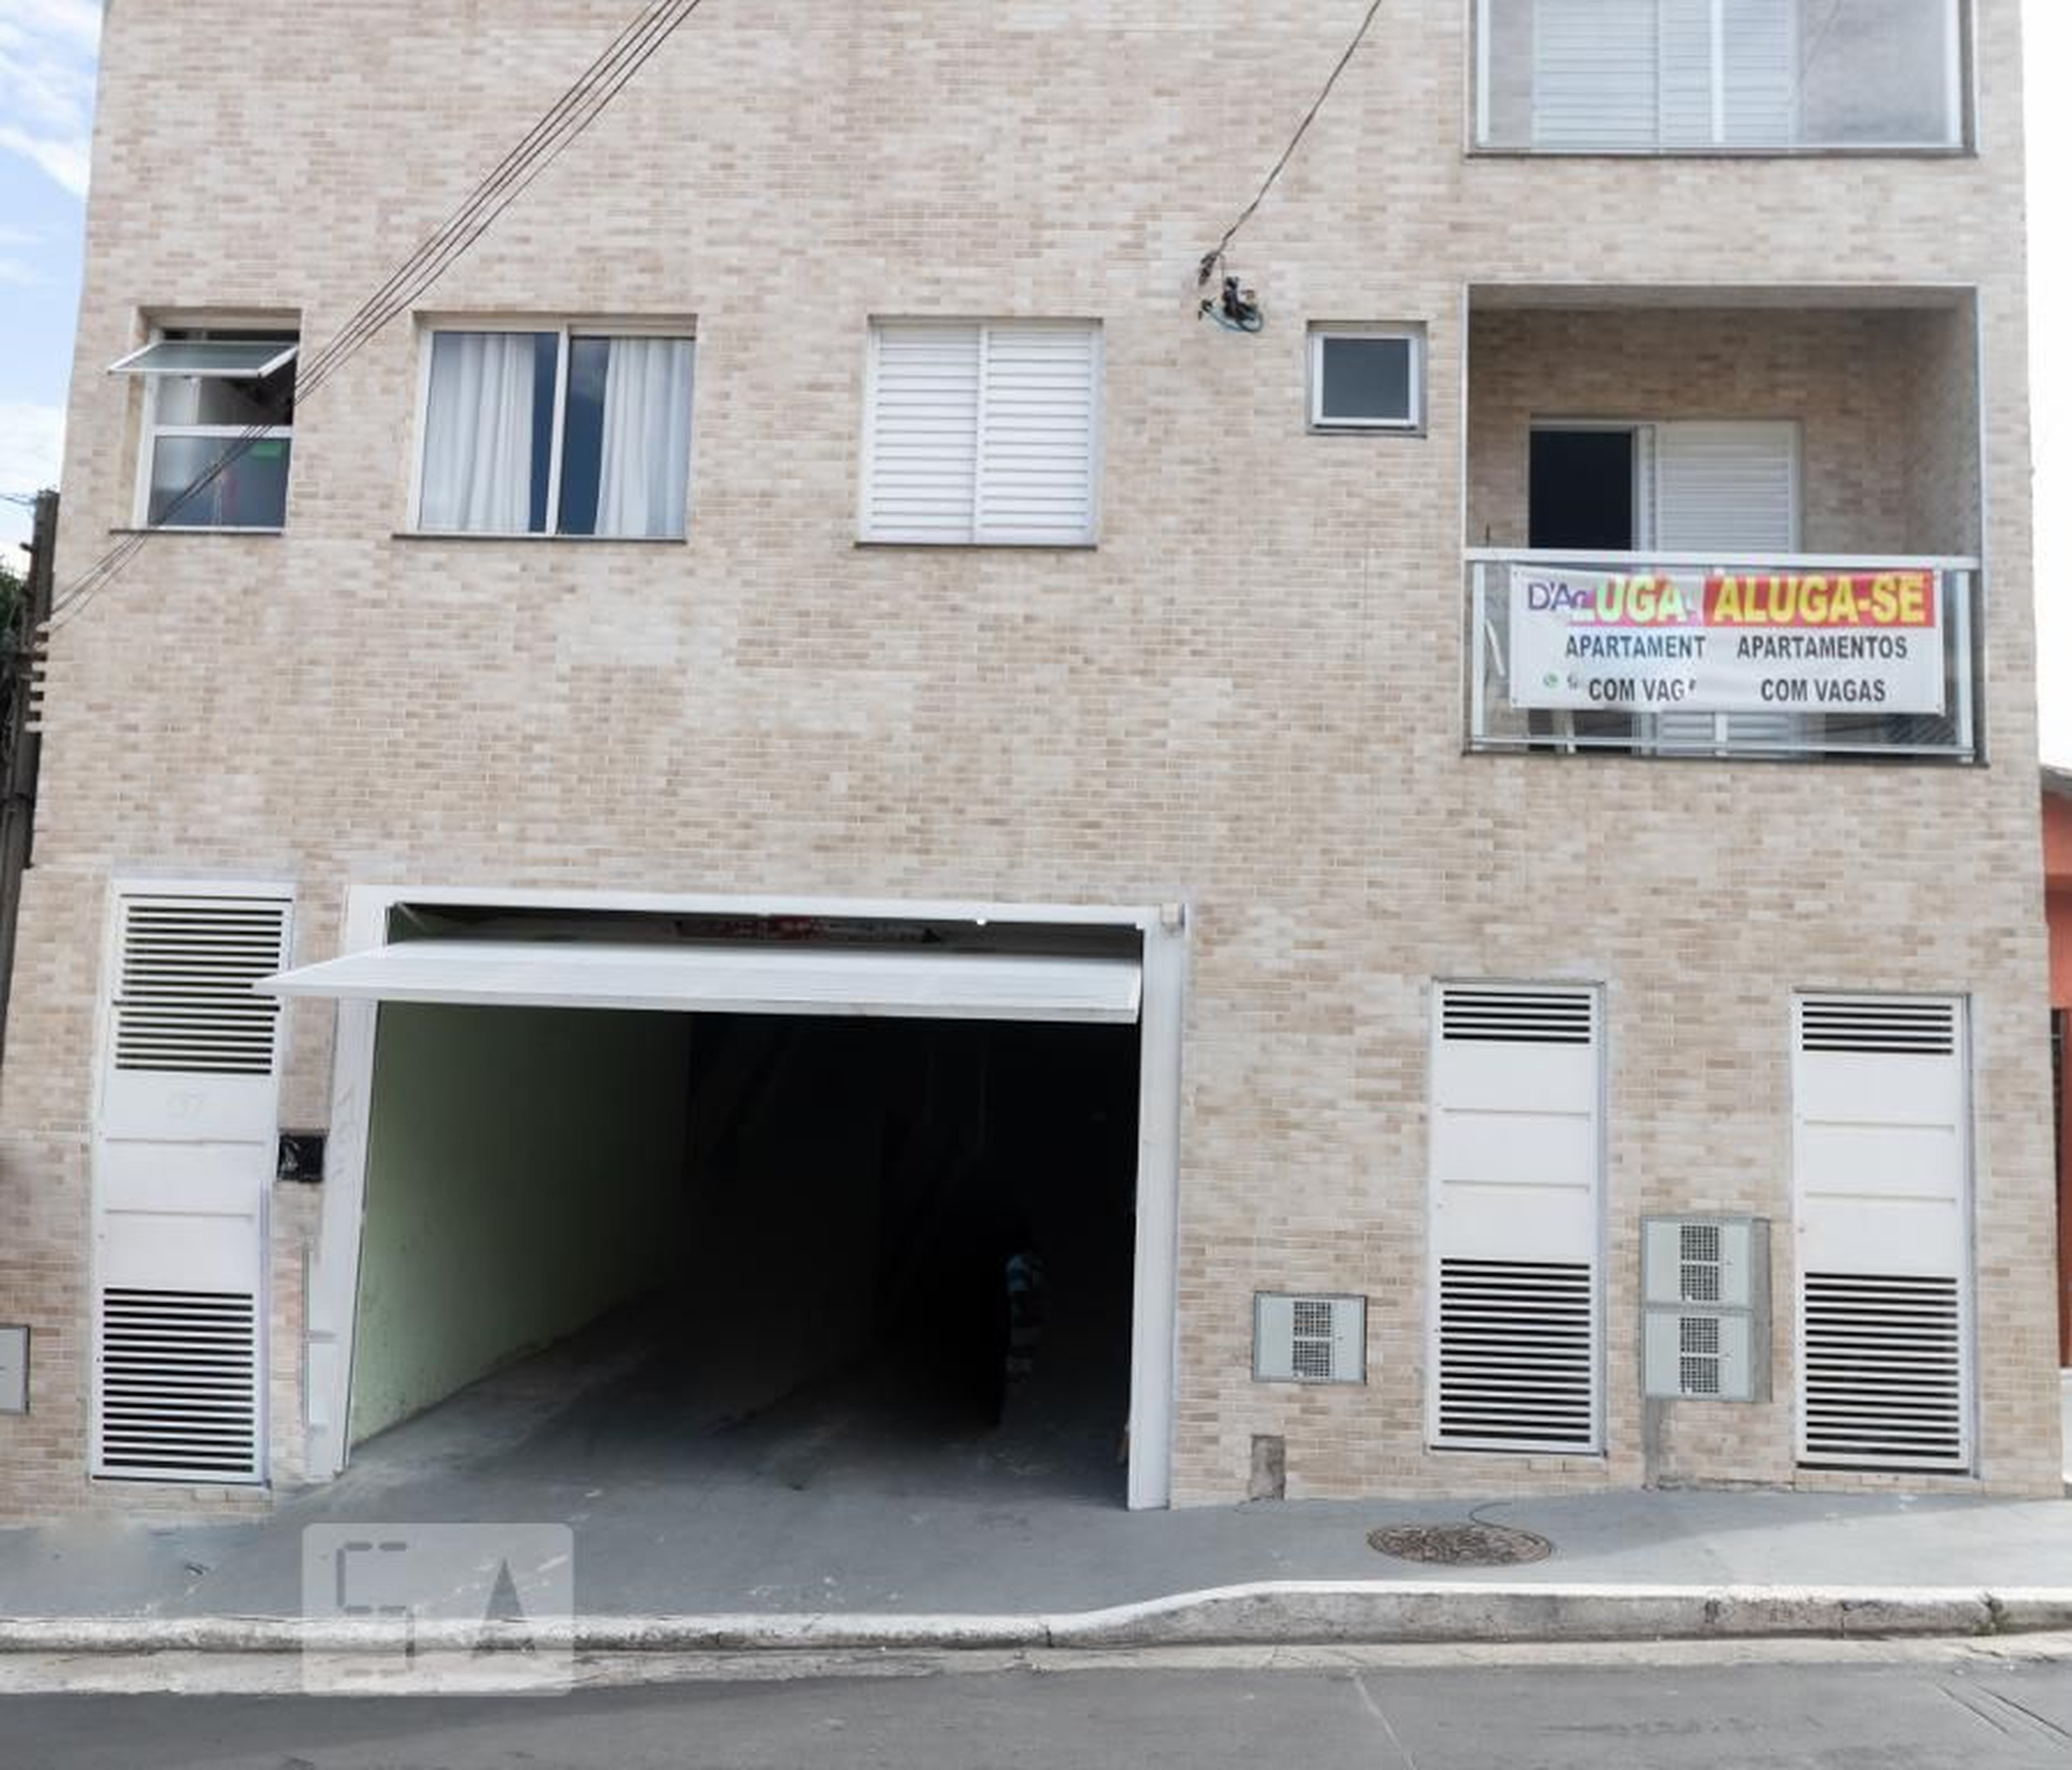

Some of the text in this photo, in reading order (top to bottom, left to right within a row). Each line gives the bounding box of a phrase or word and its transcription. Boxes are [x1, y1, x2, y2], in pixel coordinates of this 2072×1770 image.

[1713, 573, 1925, 623] ALUGA-SE
[1565, 635, 1706, 658] APARTAMENT
[1737, 636, 1908, 659] APARTAMENTOS
[1589, 678, 1635, 702] COM
[1761, 678, 1886, 702] COM VAGAS
